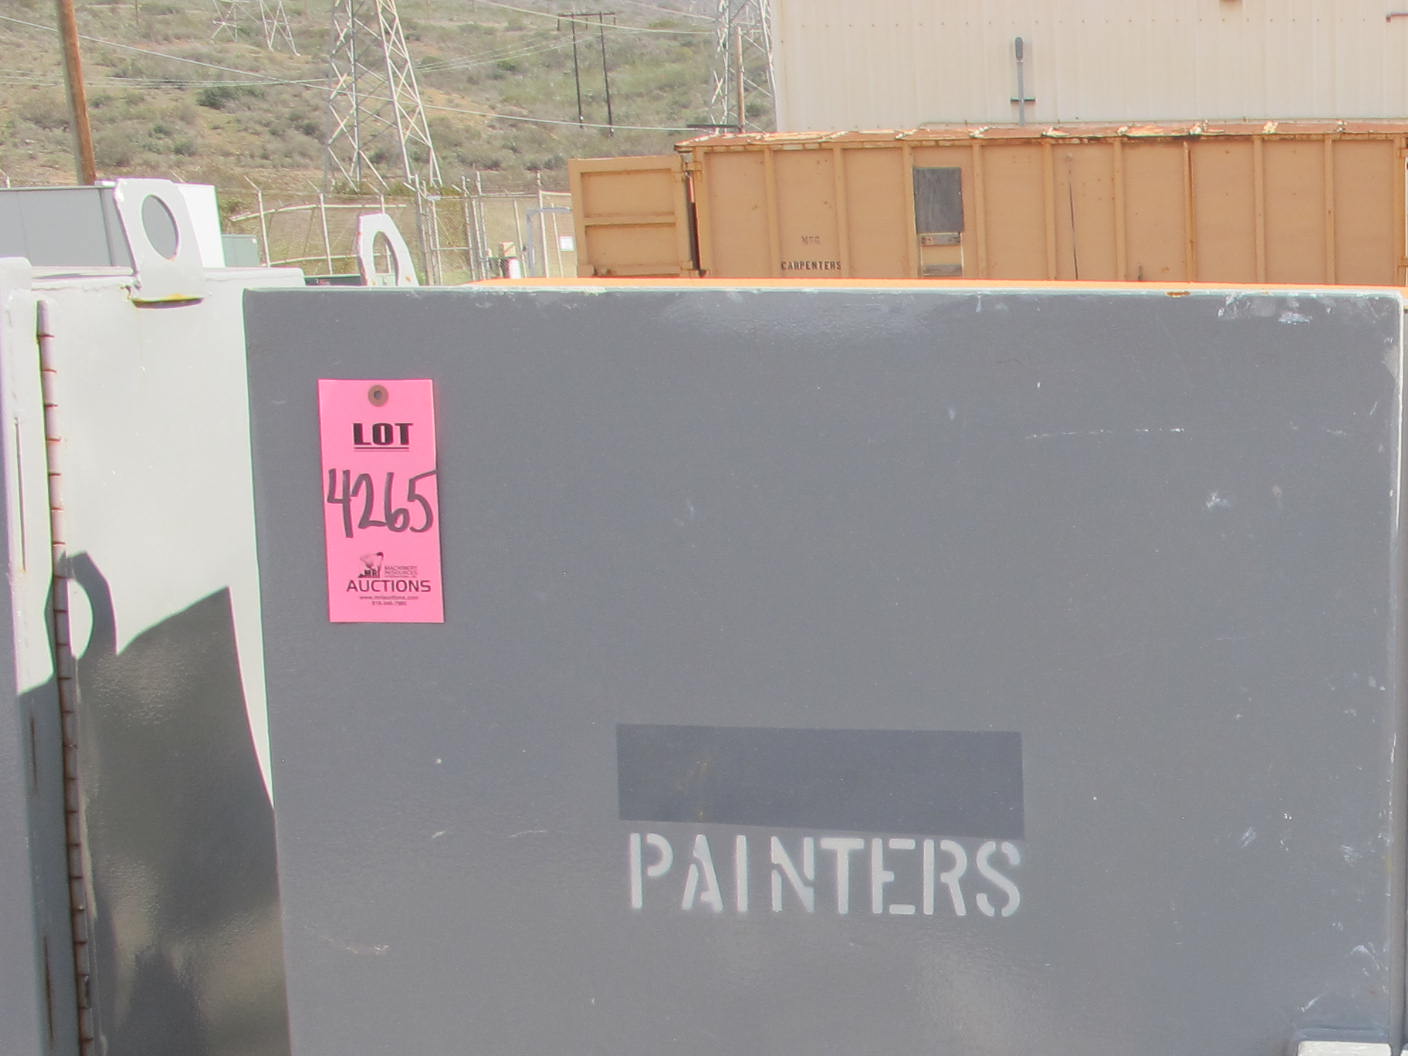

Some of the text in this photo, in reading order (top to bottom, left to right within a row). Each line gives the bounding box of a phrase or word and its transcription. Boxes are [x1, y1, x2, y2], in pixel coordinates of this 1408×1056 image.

[780, 260, 841, 271] CARPENTERS
[352, 422, 413, 446] LOT
[326, 467, 437, 539] 4265
[346, 580, 432, 593] AUCTIONS
[628, 831, 1022, 918] PAINTERS
